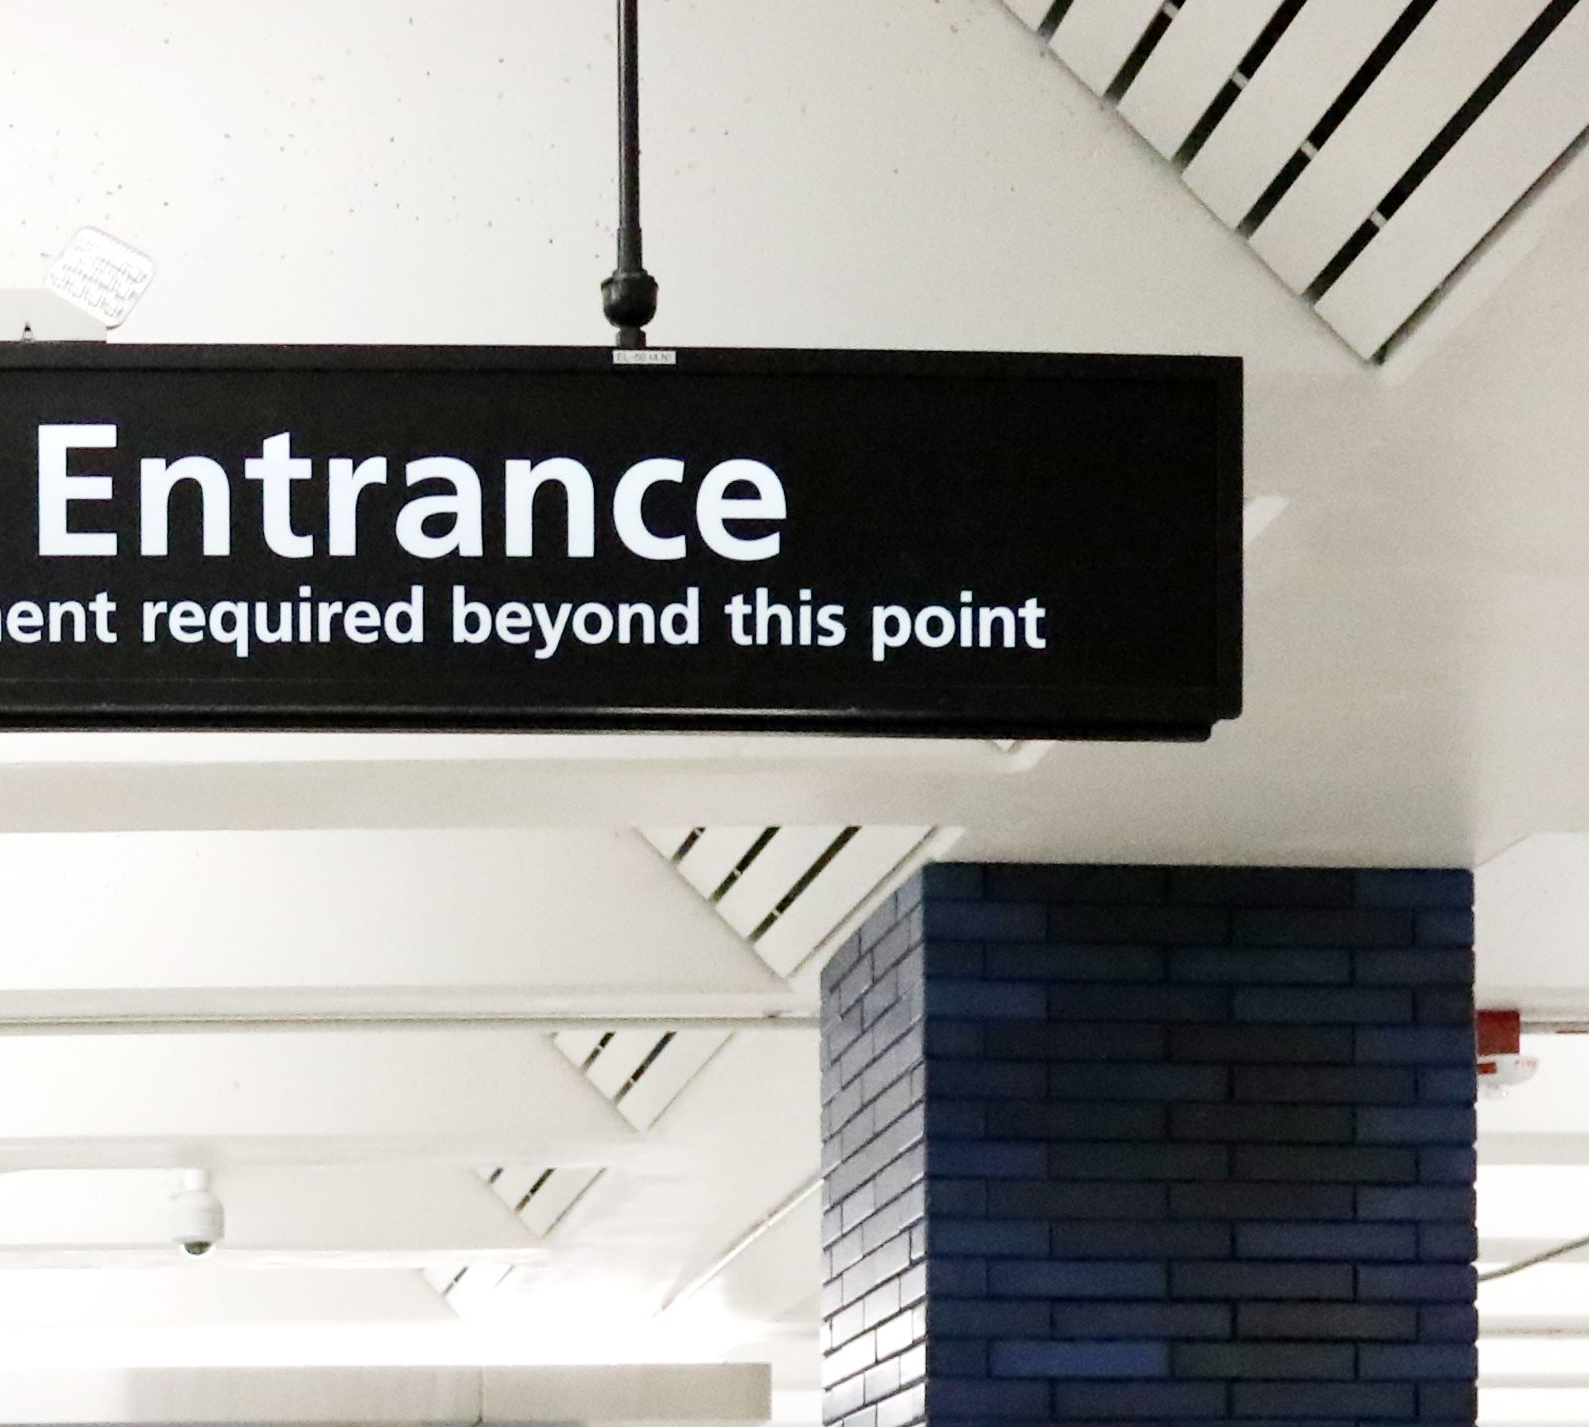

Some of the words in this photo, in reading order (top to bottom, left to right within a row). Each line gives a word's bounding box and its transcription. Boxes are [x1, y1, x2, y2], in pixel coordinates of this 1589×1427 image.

[37, 424, 788, 560] Entrance
[142, 586, 424, 657] required
[453, 586, 699, 660] beyond
[726, 588, 846, 647] this
[872, 590, 1046, 662] point
